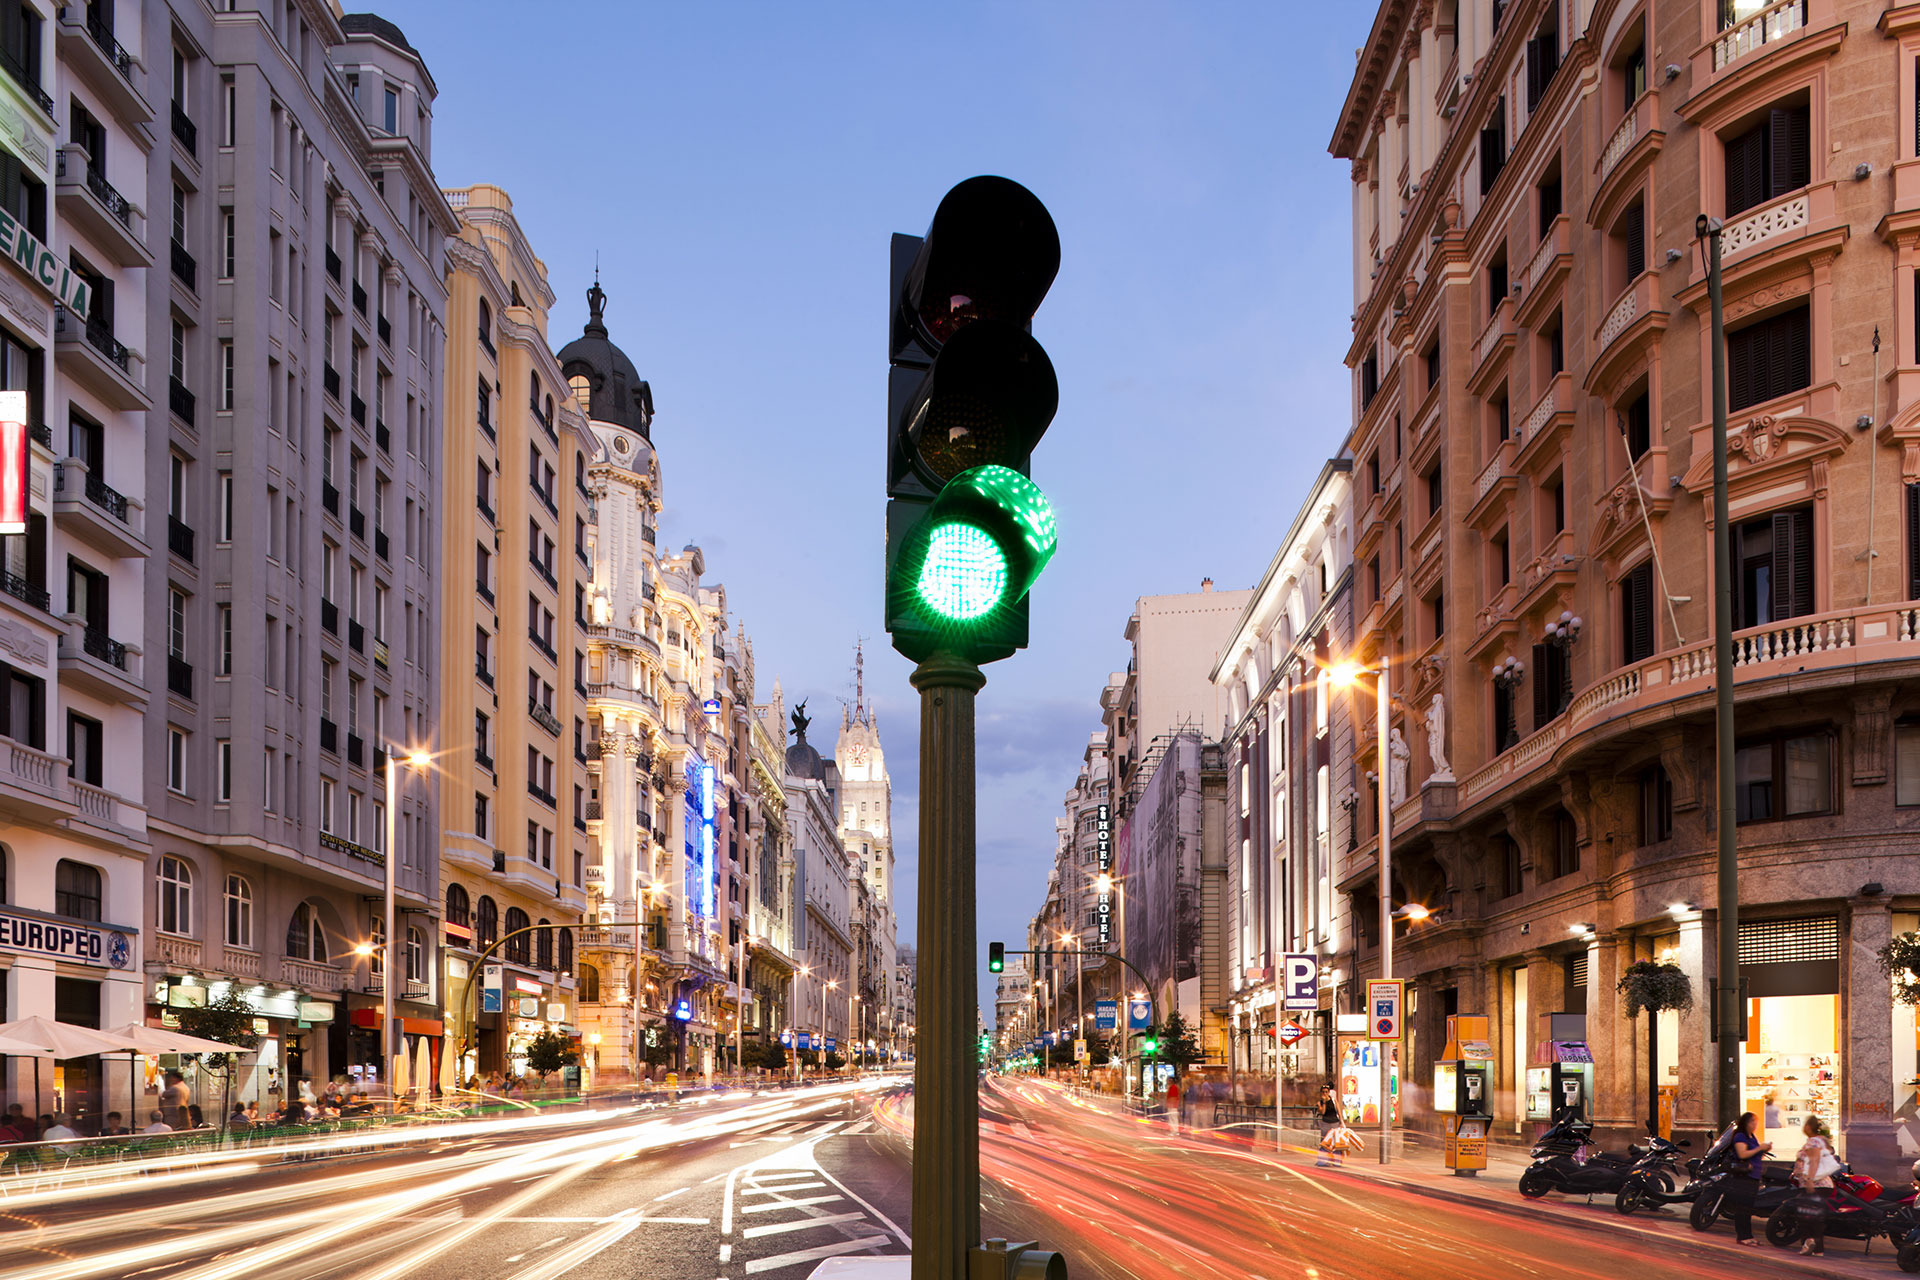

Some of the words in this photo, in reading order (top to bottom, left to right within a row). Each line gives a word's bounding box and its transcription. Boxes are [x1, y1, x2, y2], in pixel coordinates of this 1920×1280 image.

[320, 834, 348, 847] CENTRO
[350, 844, 359, 852] DE
[1098, 821, 1109, 869] HOTEL
[0, 918, 101, 958] EUROPEO
[1099, 894, 1109, 943] HOTEL
[1287, 958, 1316, 996] P
